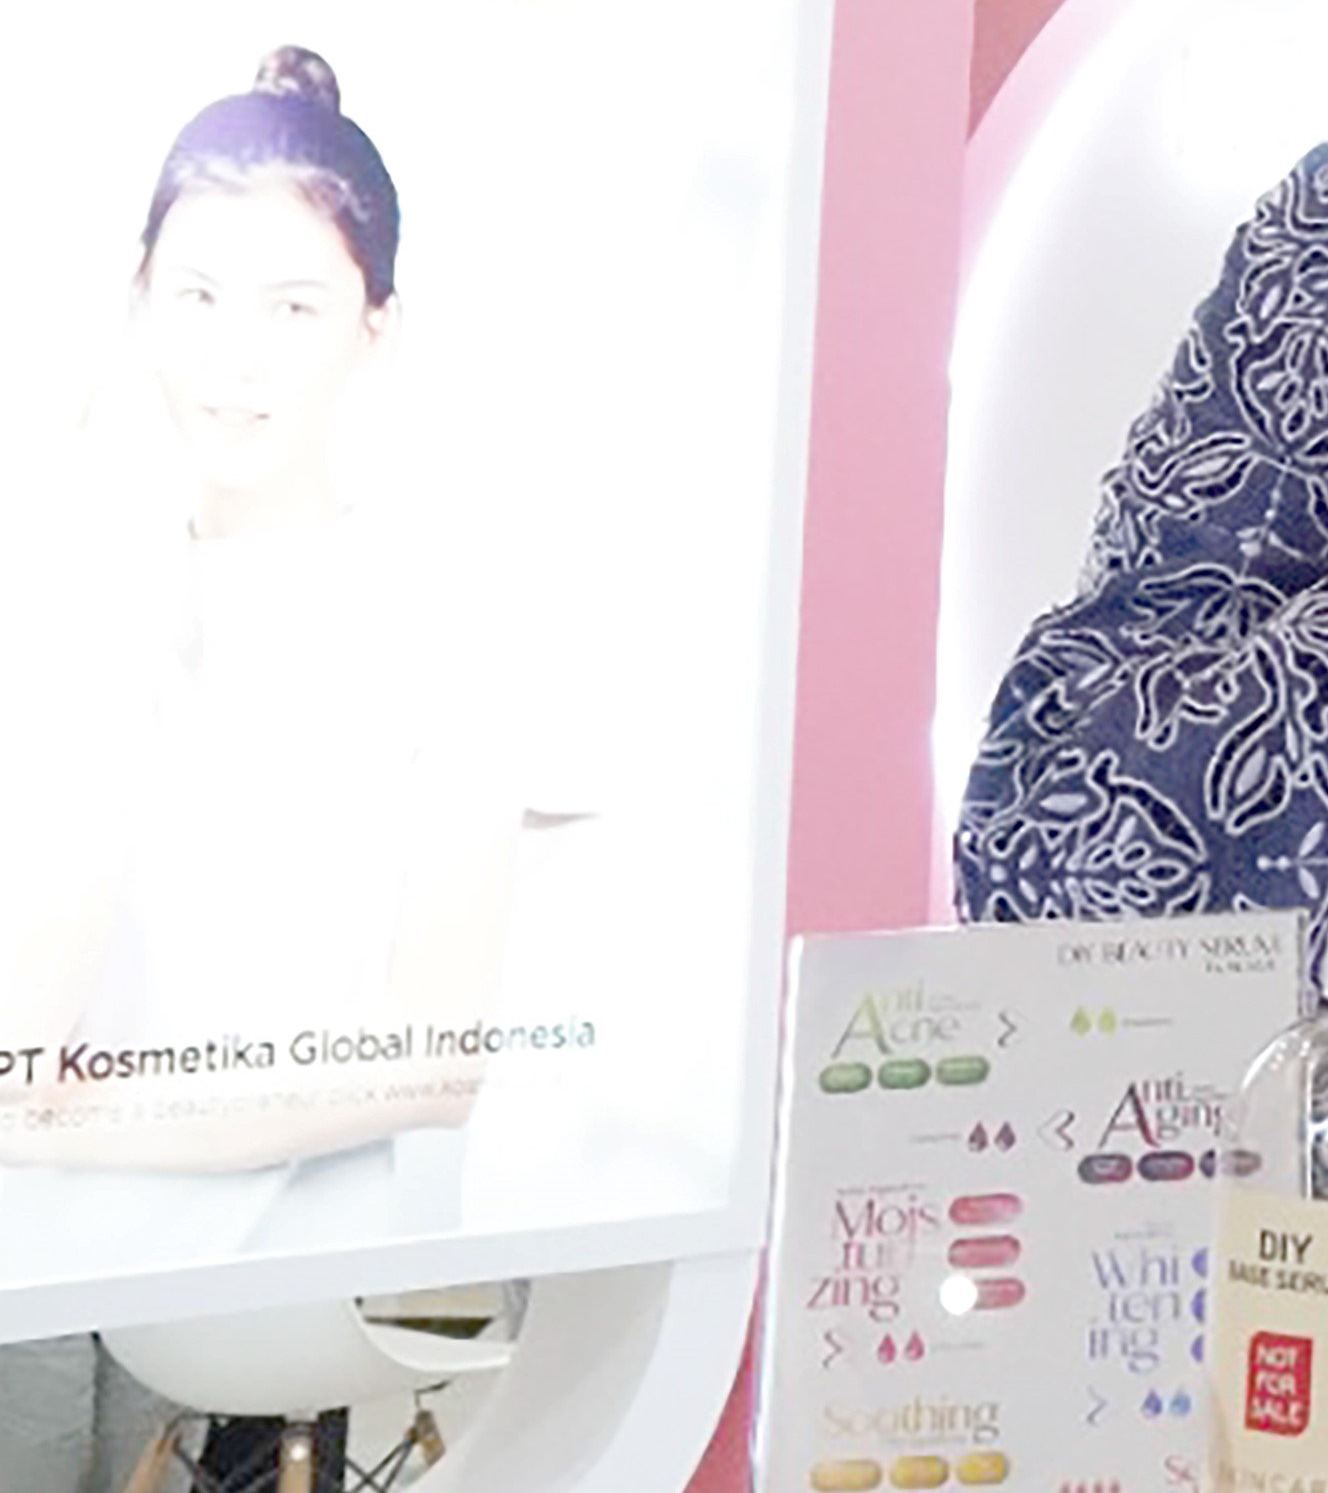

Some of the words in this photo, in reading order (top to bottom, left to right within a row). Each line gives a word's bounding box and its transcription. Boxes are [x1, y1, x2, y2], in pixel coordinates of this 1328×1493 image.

[57, 1032, 275, 1085] Kosmetika
[289, 1023, 413, 1066] Global
[424, 1014, 597, 1059] Indonesia
[1258, 1228, 1313, 1265] DIY
[1255, 1341, 1298, 1369] NOT
[1255, 1370, 1297, 1397] FOR
